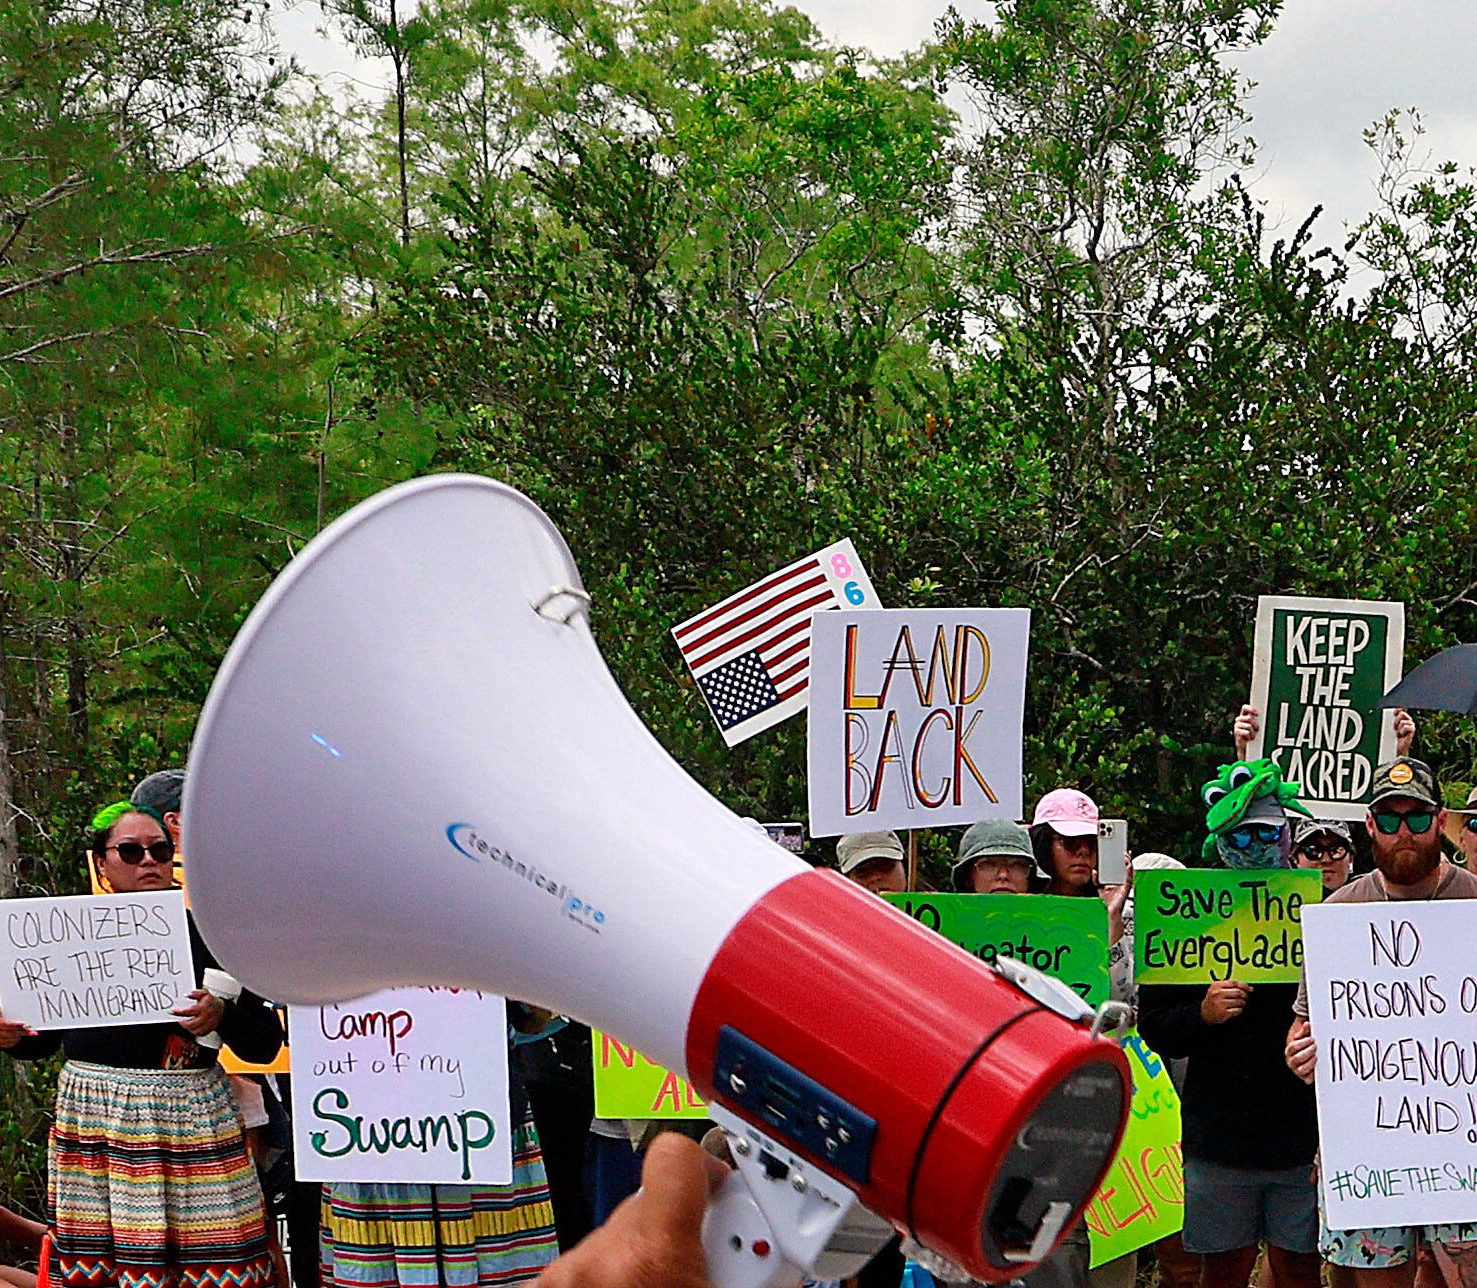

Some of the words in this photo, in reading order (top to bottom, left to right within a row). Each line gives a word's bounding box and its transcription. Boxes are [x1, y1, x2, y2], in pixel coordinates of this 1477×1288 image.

[1287, 615, 1370, 666] KEEP
[843, 624, 991, 710] LAND
[1295, 666, 1355, 707] THE
[1277, 702, 1363, 752] LAND
[844, 706, 999, 817] BACK
[1156, 880, 1233, 919] Save
[1238, 880, 1303, 923] The
[8, 904, 171, 949] COLONIZERS
[1369, 919, 1421, 968] NO
[13, 955, 61, 991] ARE
[68, 949, 115, 983] THE
[122, 948, 181, 979] REAL
[1143, 926, 1304, 981] Everglade
[1330, 974, 1446, 1021] PRISONS
[320, 1003, 414, 1057] Camp
[313, 1052, 359, 1077] out
[371, 1053, 411, 1075] of
[419, 1054, 466, 1098] my
[309, 1087, 496, 1181] Swamp
